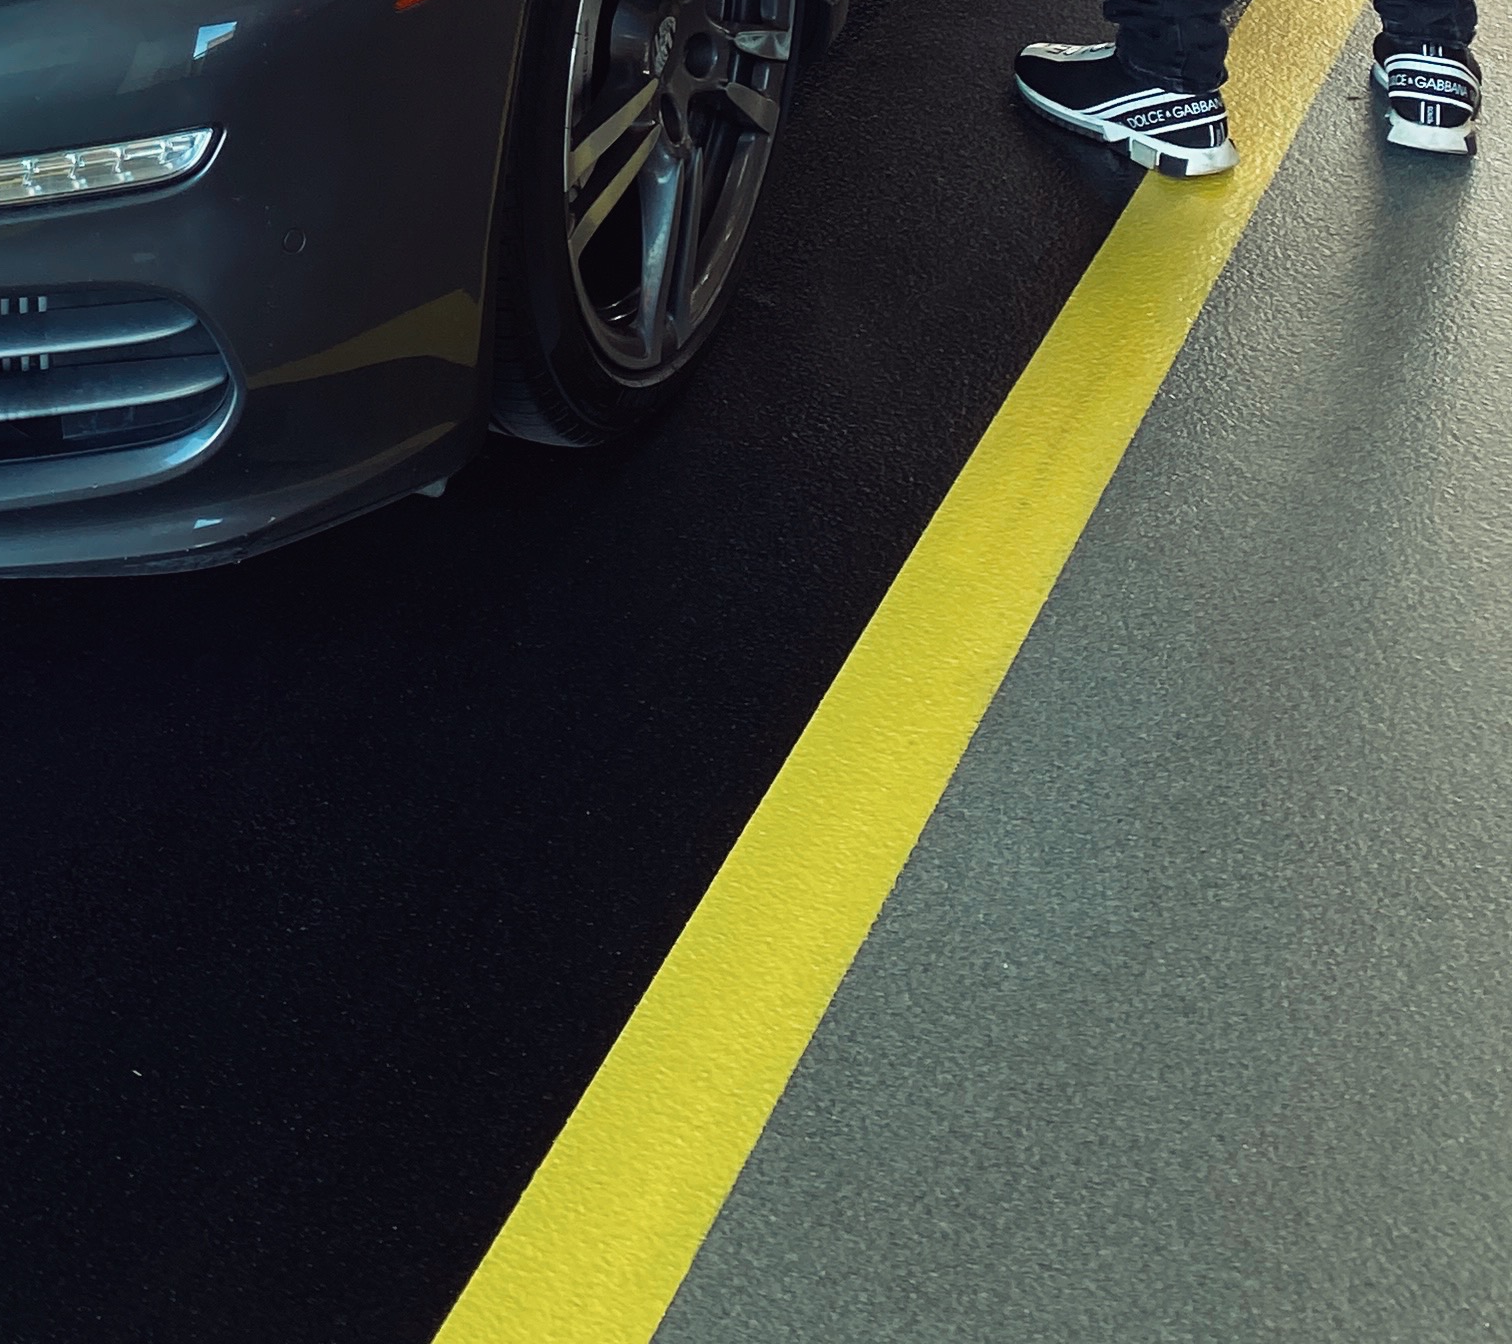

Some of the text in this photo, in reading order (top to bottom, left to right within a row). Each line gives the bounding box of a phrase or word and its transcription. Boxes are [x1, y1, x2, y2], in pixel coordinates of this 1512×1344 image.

[1414, 76, 1468, 97] GABBANA
[1127, 109, 1165, 128] DOLCE
[1165, 110, 1172, 118] &
